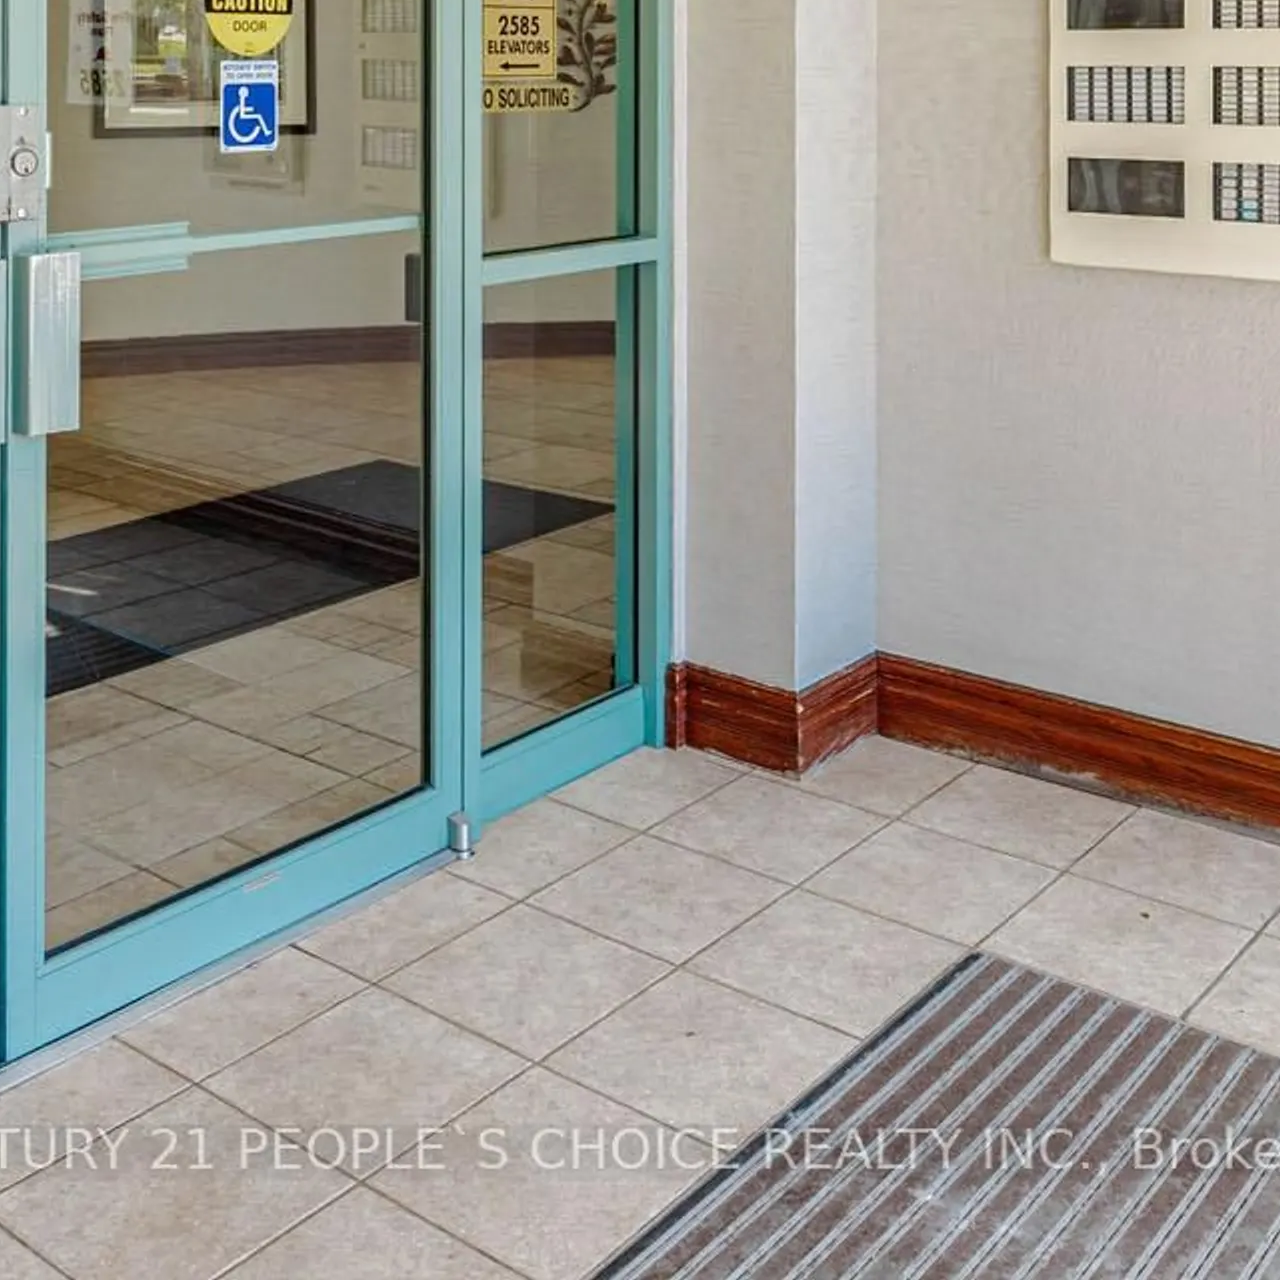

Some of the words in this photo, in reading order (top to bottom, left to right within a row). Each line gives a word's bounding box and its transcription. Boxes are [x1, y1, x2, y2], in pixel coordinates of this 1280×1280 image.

[232, 20, 267, 32] DOOR
[498, 15, 540, 36] 2585
[487, 39, 551, 55] ELEVATORS
[483, 89, 494, 108] O
[498, 87, 570, 108] SOLICITING
